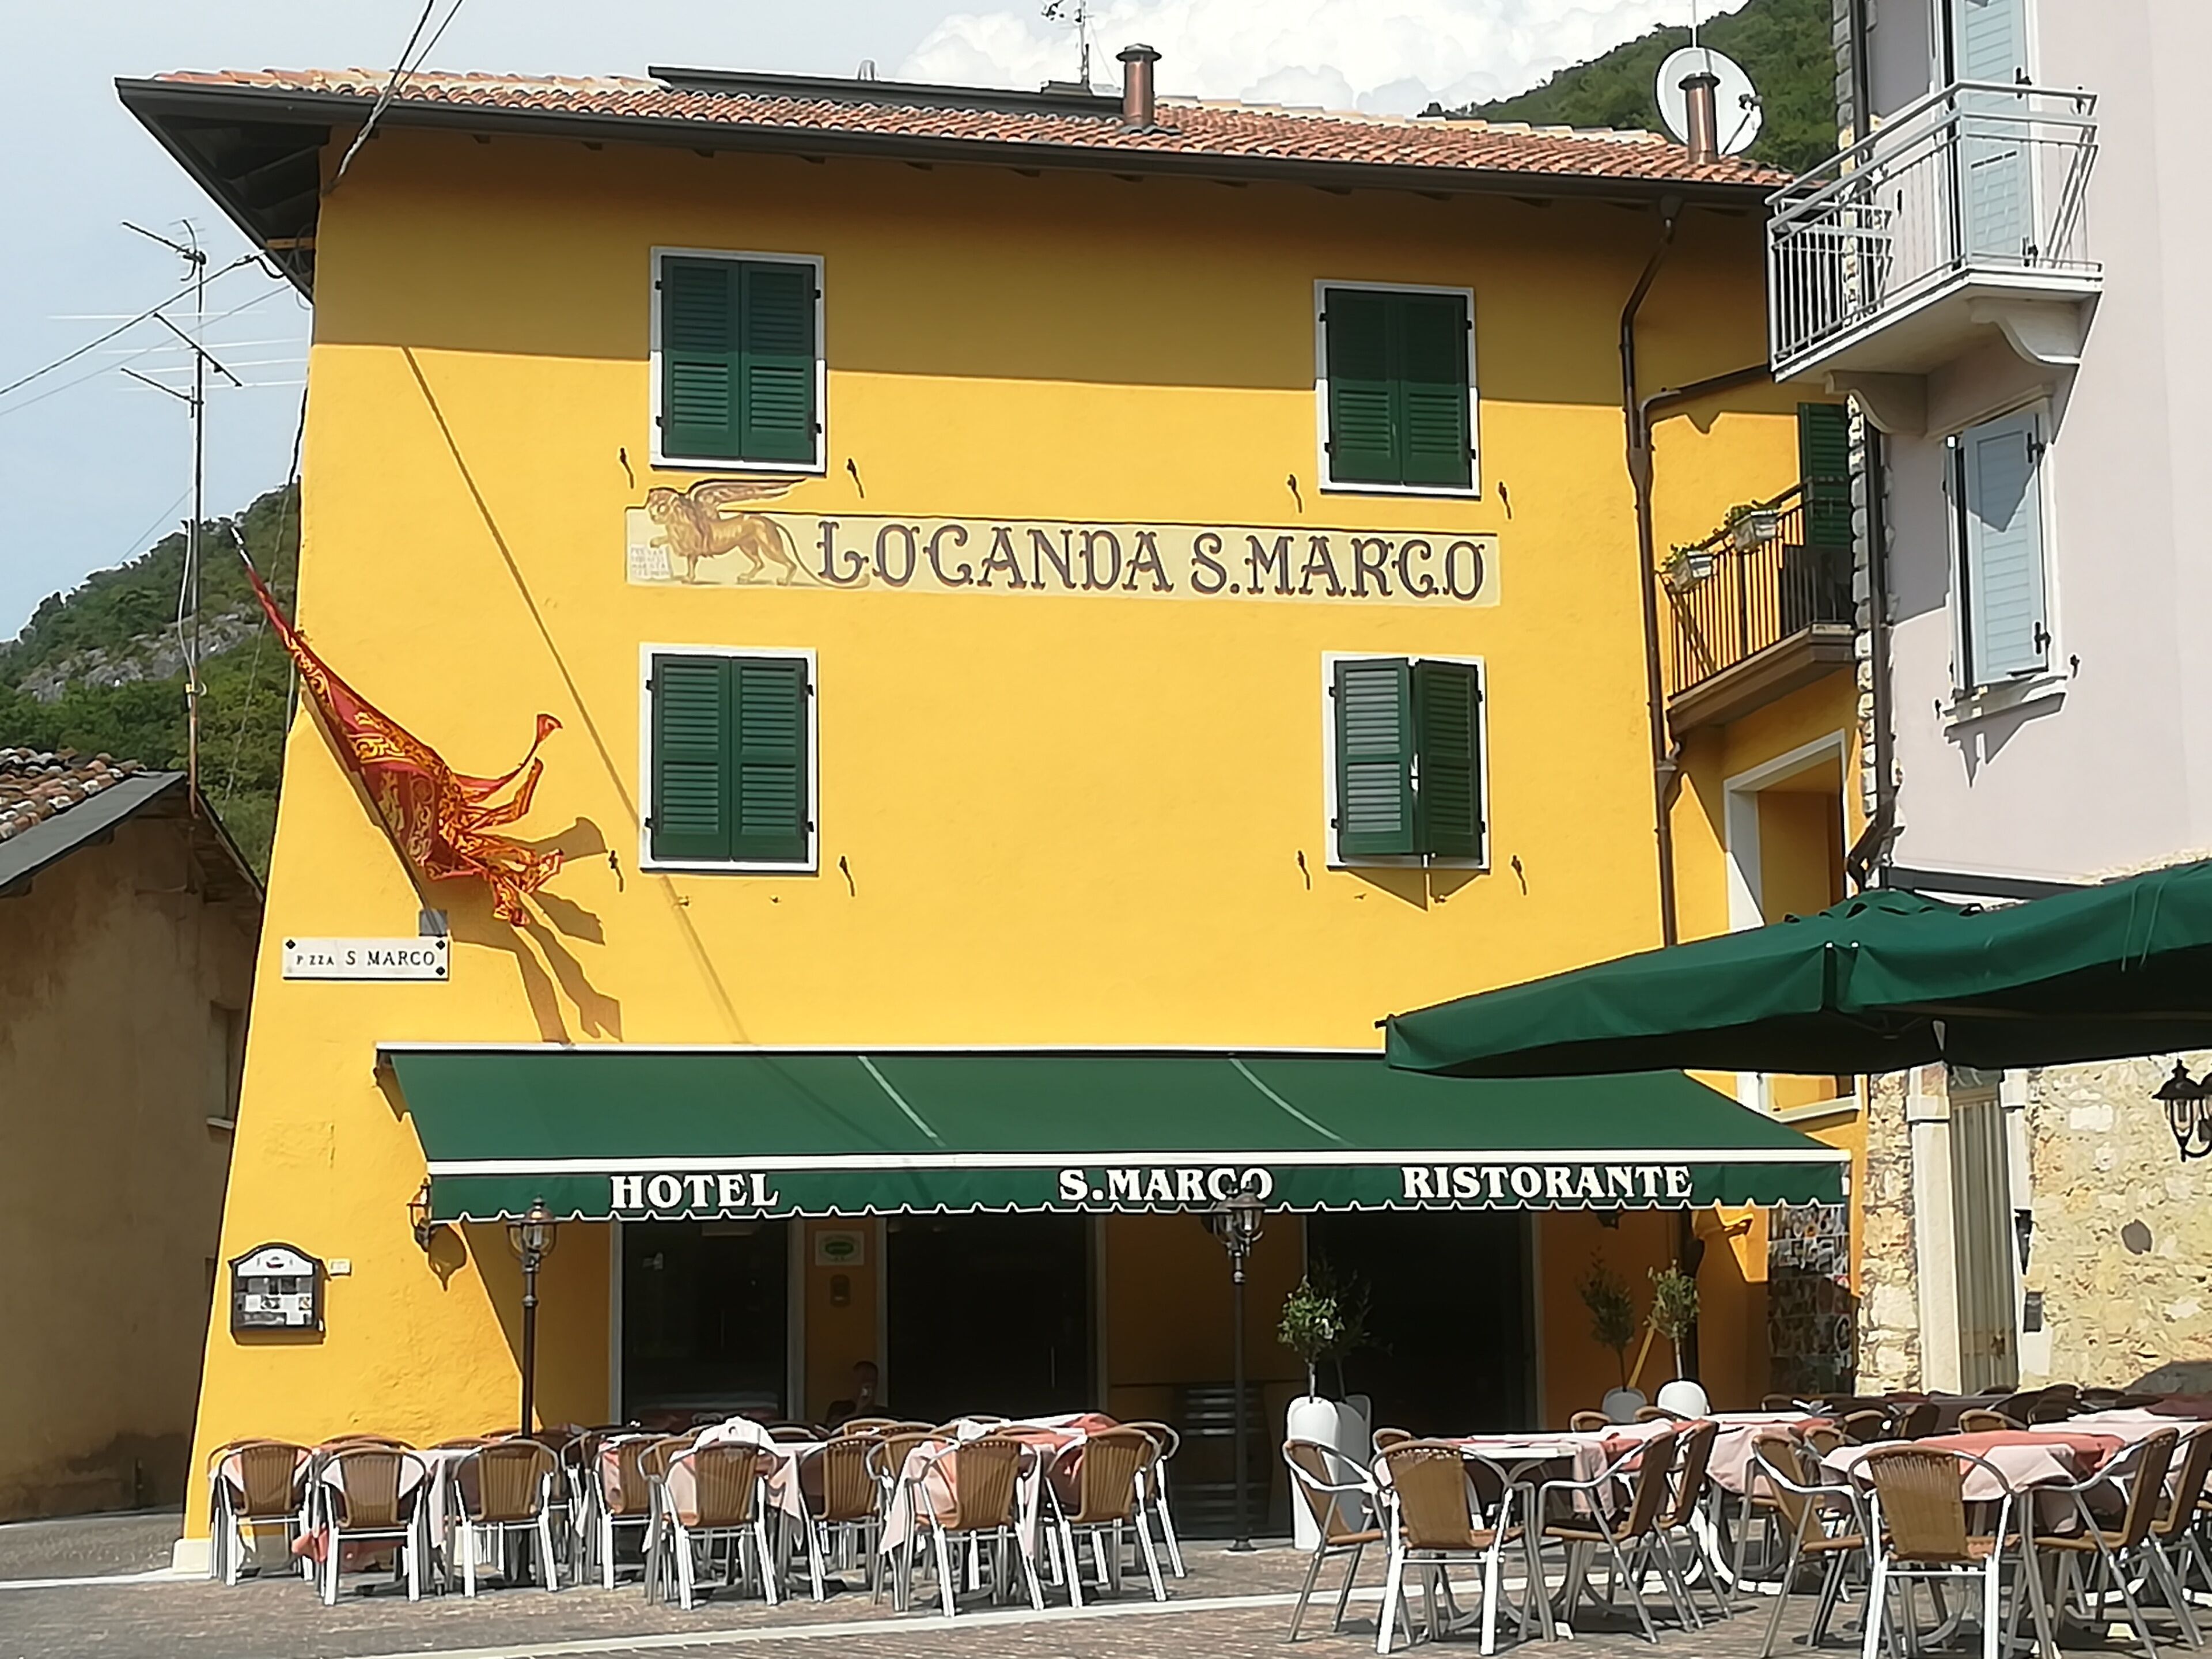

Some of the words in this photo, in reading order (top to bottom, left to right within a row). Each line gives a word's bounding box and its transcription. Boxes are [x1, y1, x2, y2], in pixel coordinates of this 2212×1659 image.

[816, 520, 1174, 592] LOCANDA
[1190, 532, 1486, 601] S.MARCO
[366, 950, 435, 966] MARCO
[610, 1173, 778, 1209] HOTEL
[1059, 1168, 1273, 1201] S.MARCO
[1401, 1165, 1693, 1199] RISTORANTE
